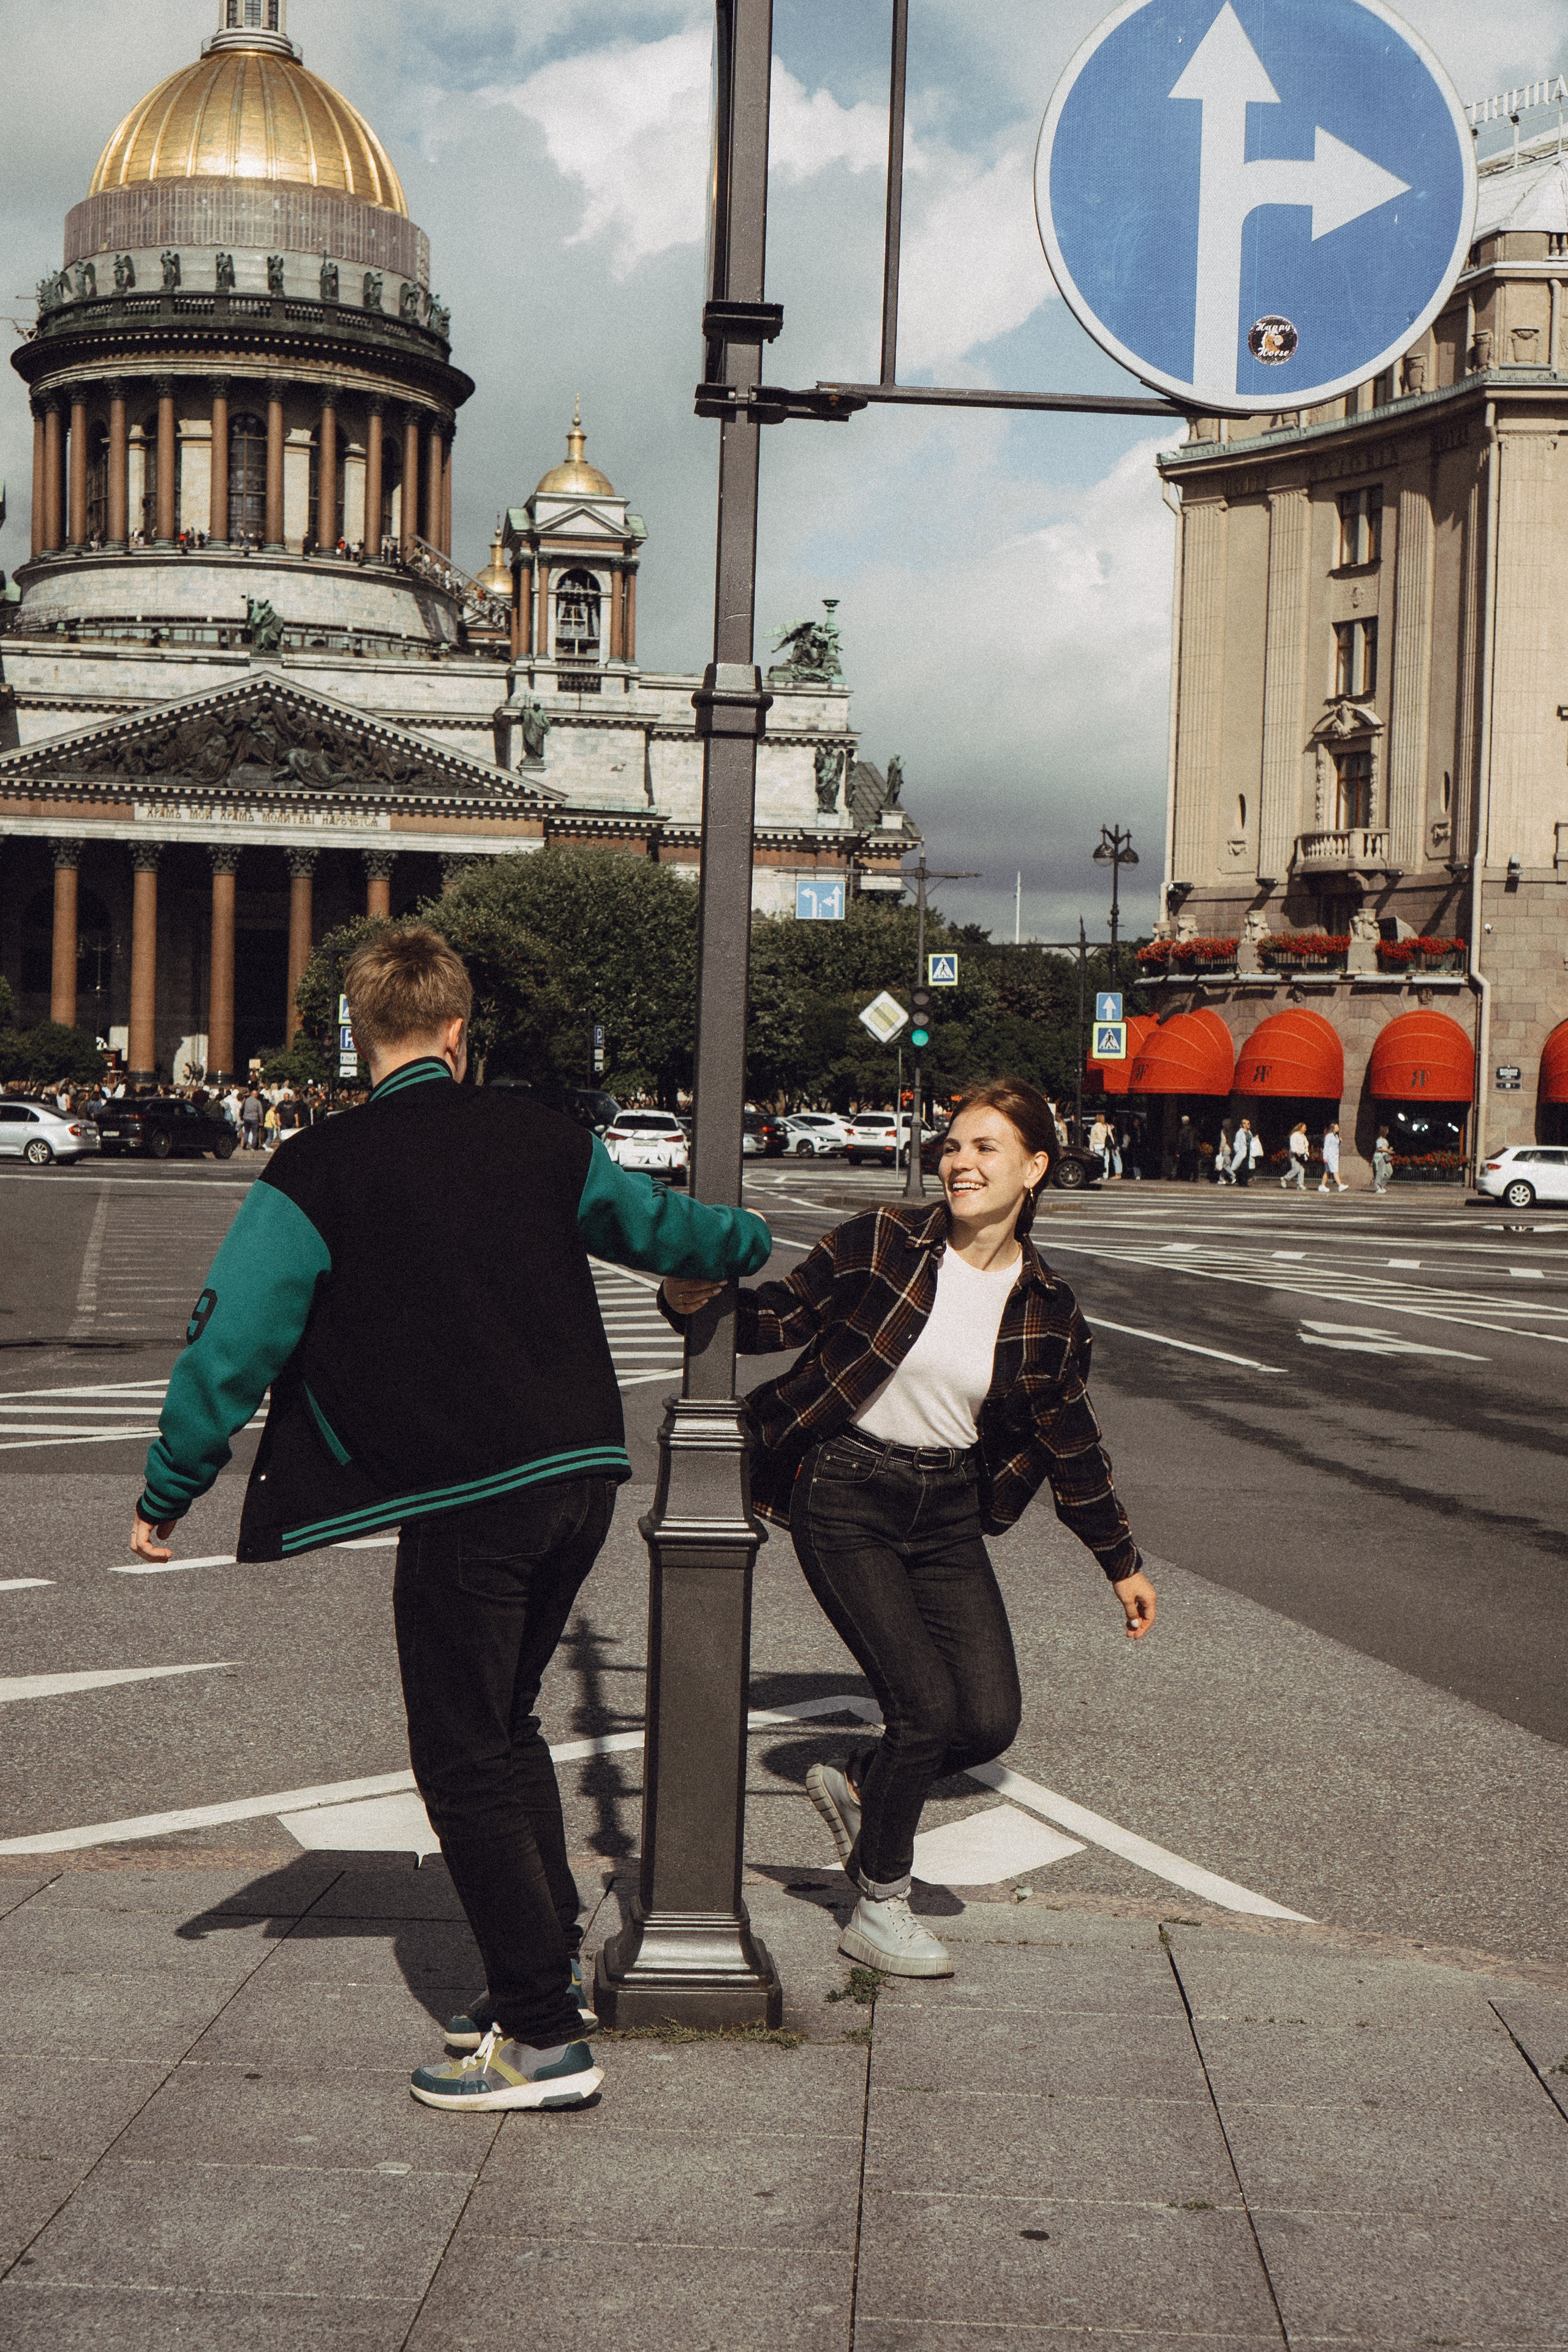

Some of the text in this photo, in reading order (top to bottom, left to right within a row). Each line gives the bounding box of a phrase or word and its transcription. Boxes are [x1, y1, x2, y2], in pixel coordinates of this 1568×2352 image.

[1469, 74, 1568, 125] ИНИЦА
[1256, 323, 1291, 335] Happy
[1257, 347, 1289, 356] Horse
